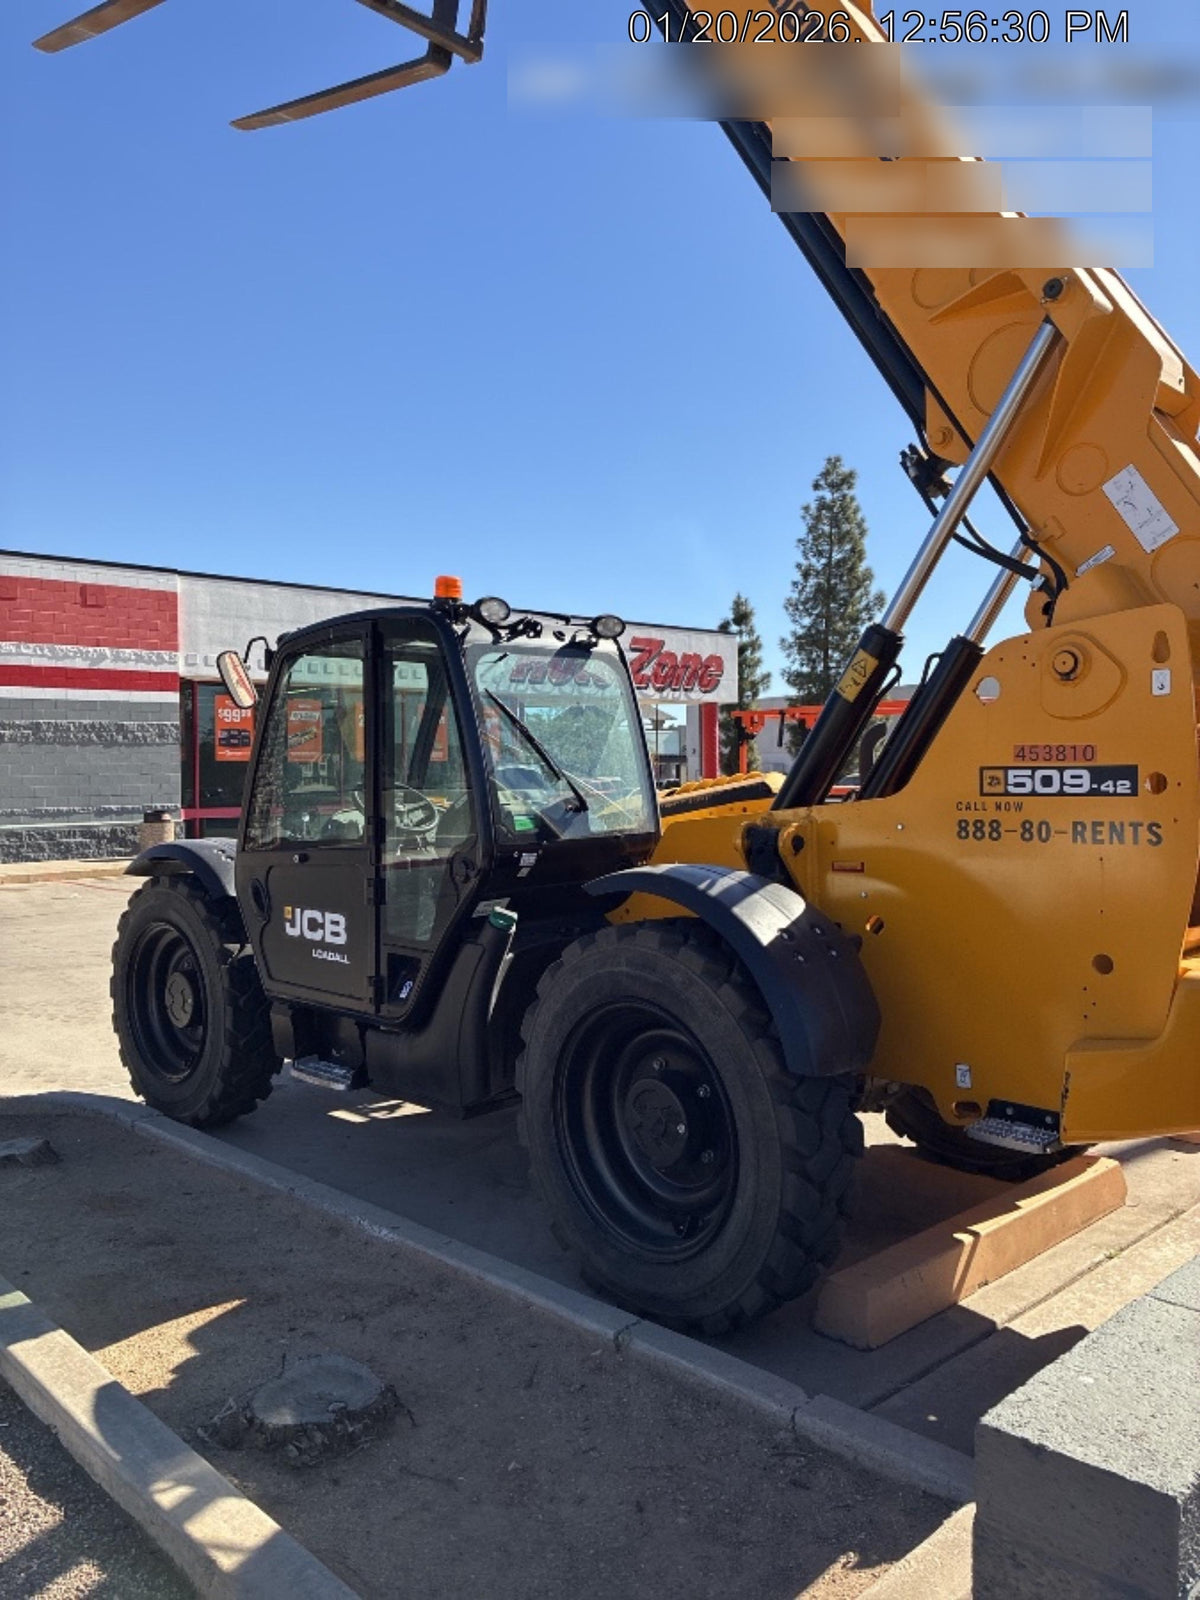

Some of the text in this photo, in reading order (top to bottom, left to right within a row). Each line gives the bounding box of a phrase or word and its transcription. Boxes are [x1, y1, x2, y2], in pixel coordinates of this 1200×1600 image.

[1015, 745, 1096, 762] 453810
[1006, 768, 1133, 794] 509-42
[956, 801, 1024, 813] CALL NOW
[956, 818, 1164, 847] 888-80-RENTS
[284, 907, 348, 945] JCB
